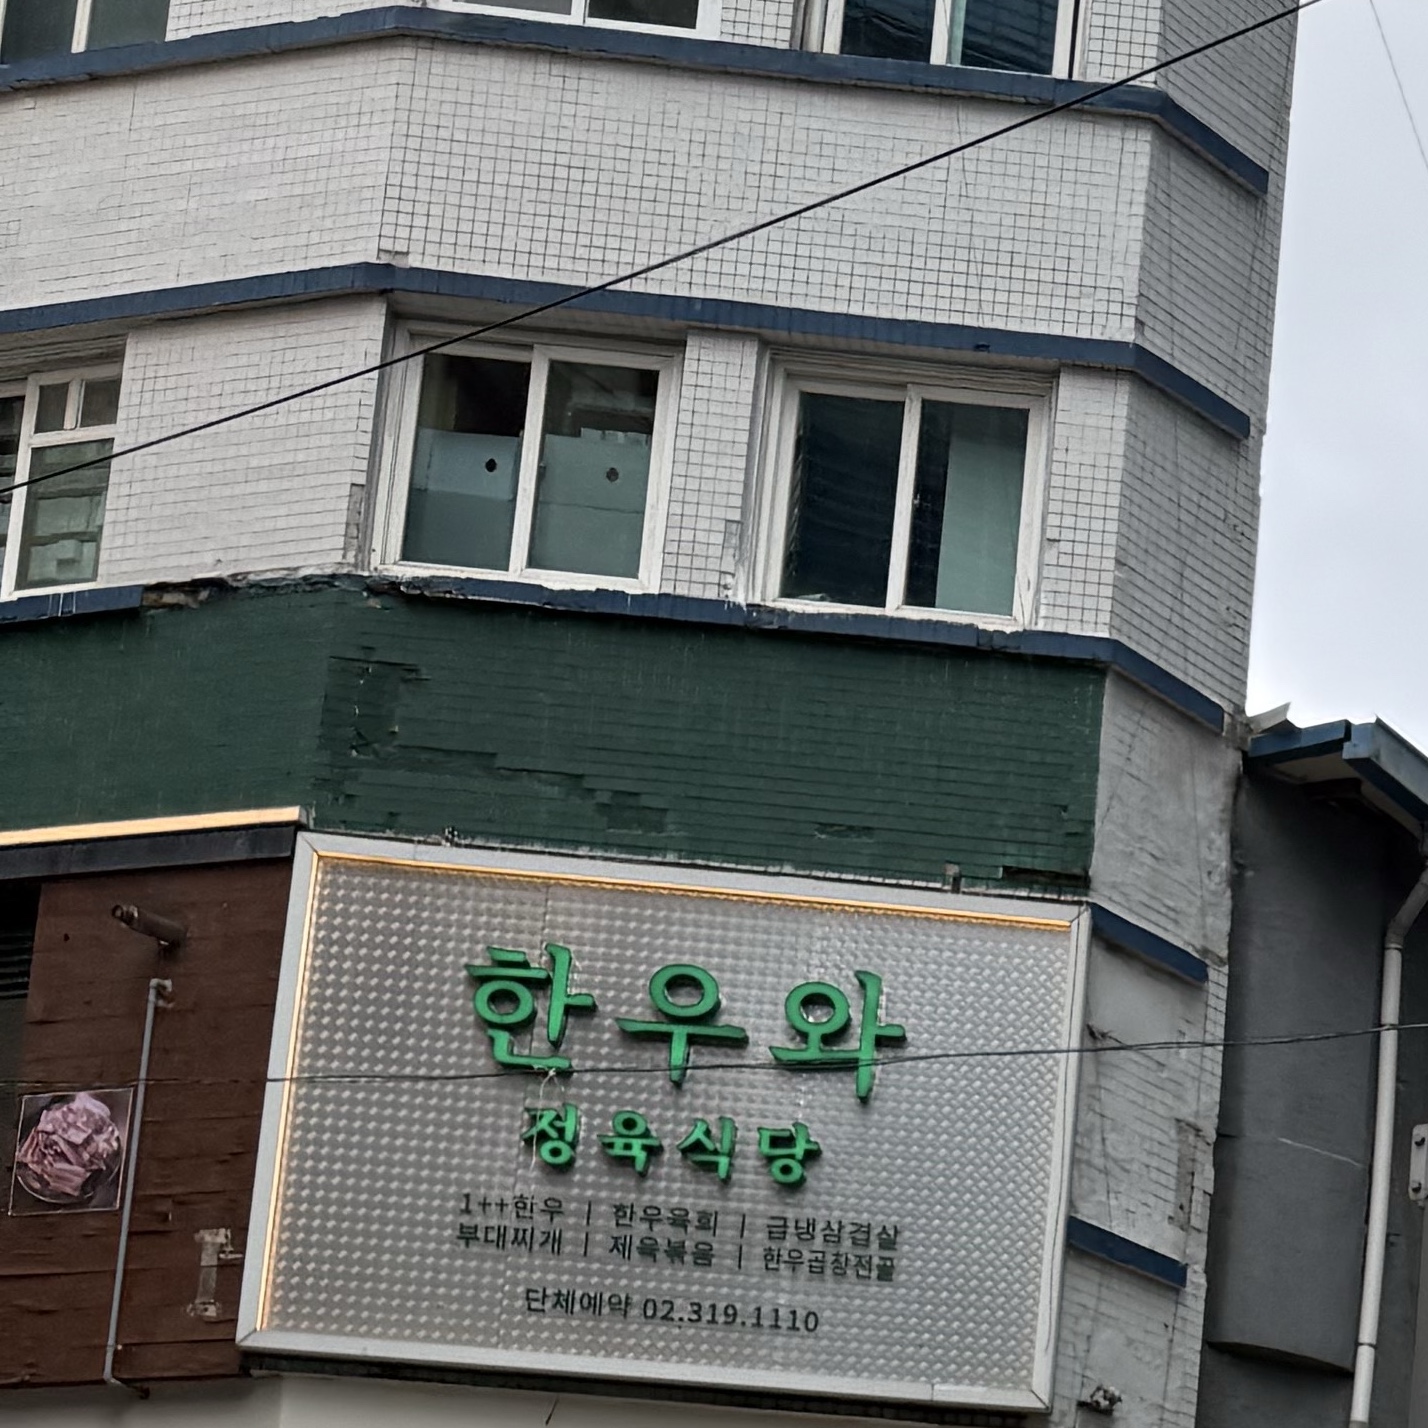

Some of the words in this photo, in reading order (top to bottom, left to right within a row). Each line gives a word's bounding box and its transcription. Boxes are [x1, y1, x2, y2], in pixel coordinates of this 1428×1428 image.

[464, 942, 908, 1102] 한우와
[520, 1102, 823, 1185] 정육식당
[612, 1202, 719, 1237] 한우육회
[455, 1222, 564, 1256] 부대찌개
[608, 1234, 717, 1268] 제육볶음
[763, 1245, 897, 1283] 한우곱창전골
[524, 1286, 634, 1320] 단체예약
[642, 1297, 820, 1333] 02.319.1110
